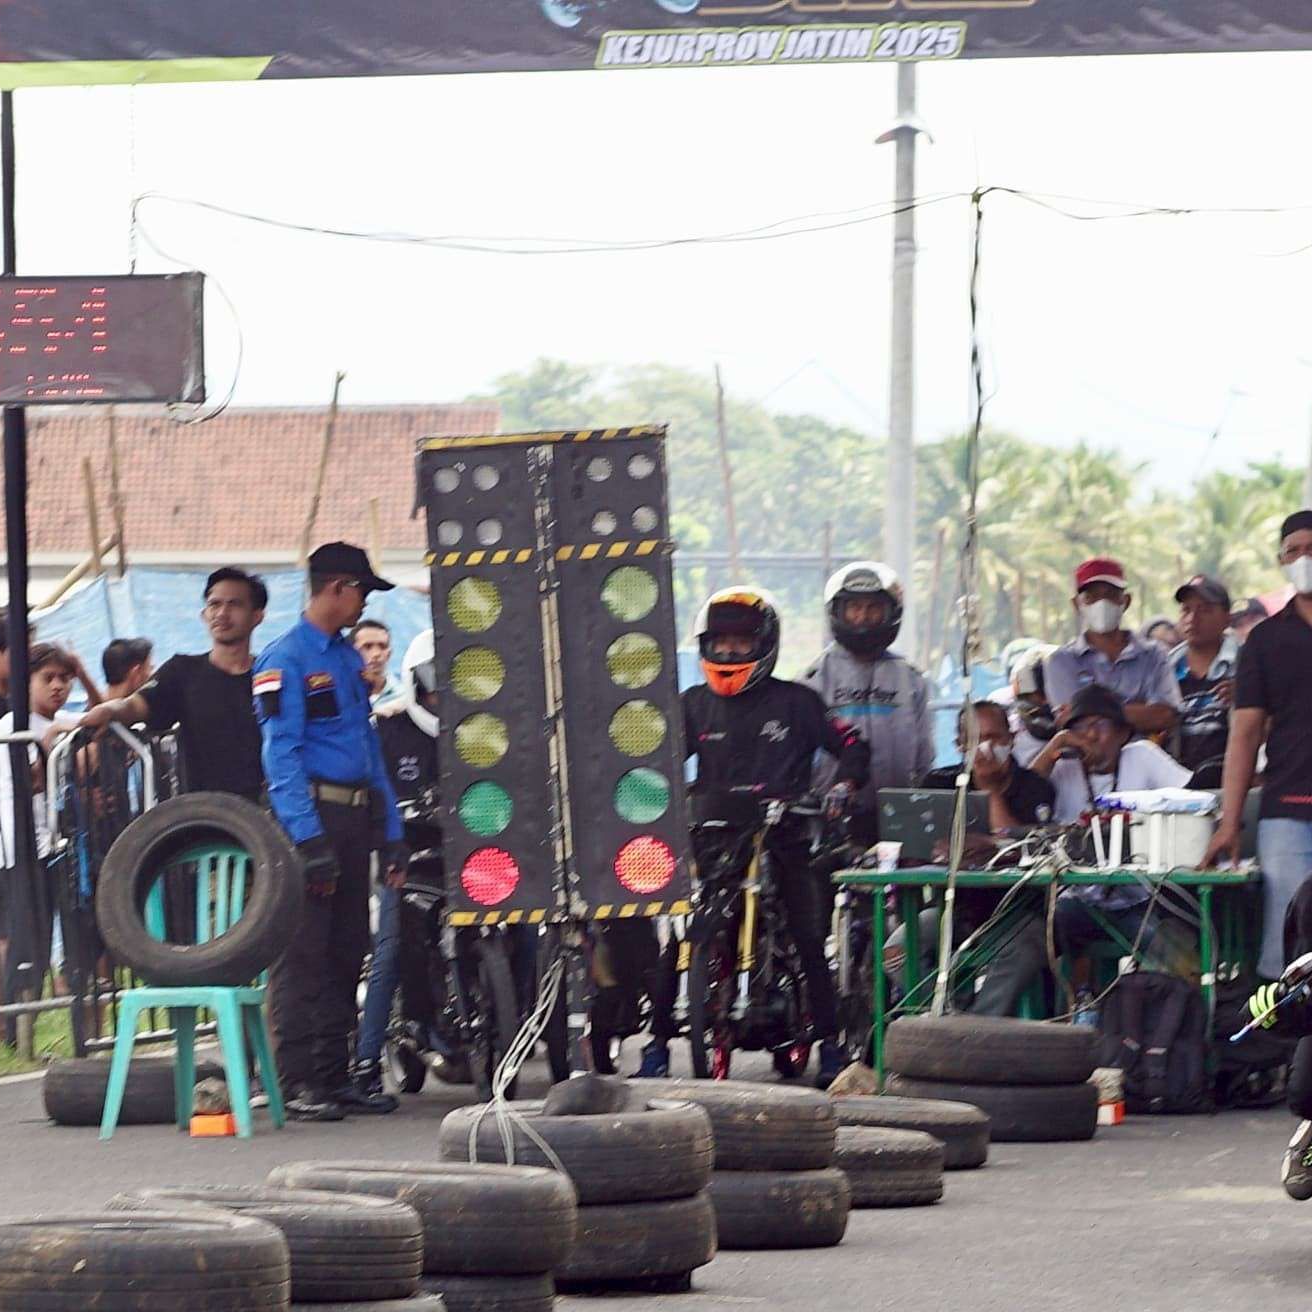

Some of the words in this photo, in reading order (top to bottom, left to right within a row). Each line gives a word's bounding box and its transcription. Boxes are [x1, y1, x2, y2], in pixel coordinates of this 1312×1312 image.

[601, 29, 781, 64] KEJURPROV
[781, 28, 873, 61] JATIM
[871, 27, 961, 58] 2025
